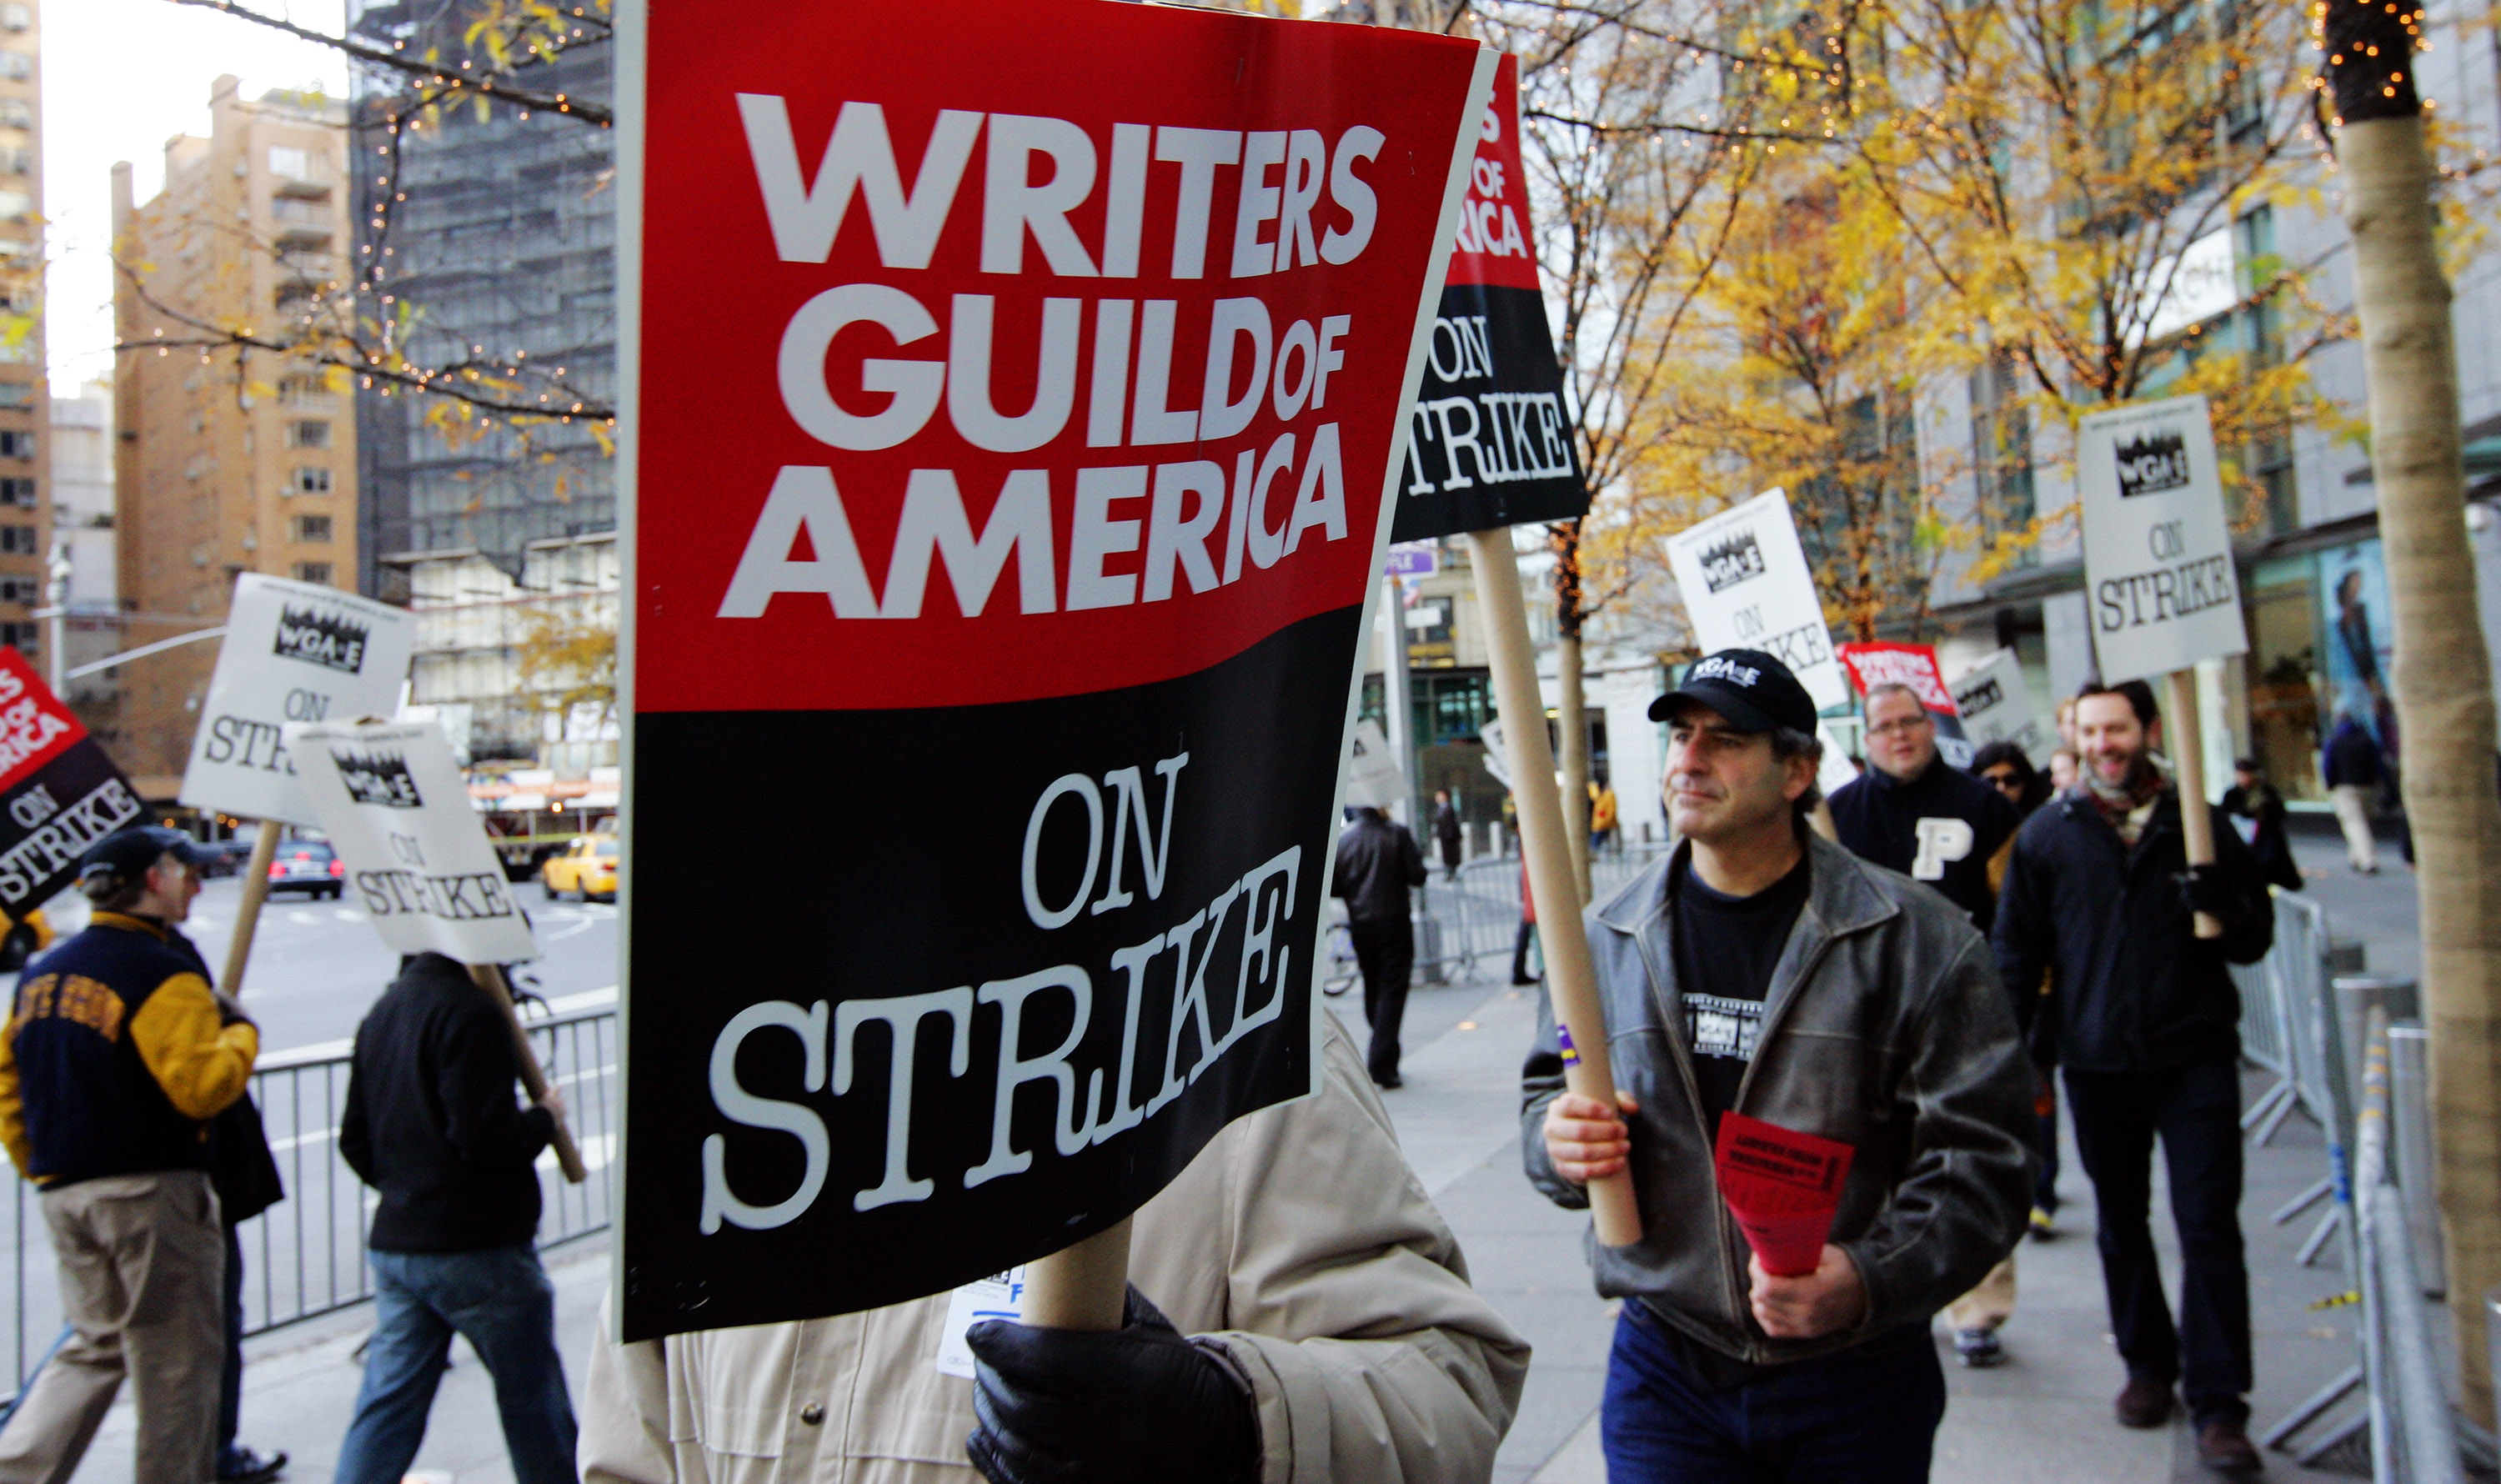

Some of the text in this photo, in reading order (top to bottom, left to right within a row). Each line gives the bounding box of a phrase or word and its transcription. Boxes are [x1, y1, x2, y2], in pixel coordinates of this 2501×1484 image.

[734, 93, 1386, 279] WRITERS
[1472, 157, 1505, 198] OF
[777, 283, 1351, 453] GUILD OF
[1429, 316, 1493, 383] ON
[1408, 393, 1573, 497] TRIKE
[715, 422, 1348, 619] AMERICA
[2148, 519, 2185, 562] ON
[1732, 604, 1765, 640] ON
[2098, 554, 2233, 632] STRIKE
[283, 688, 331, 721] ON
[0, 778, 142, 905] STRIKE
[9, 783, 59, 829] ON
[1021, 751, 1189, 930] ON
[1912, 818, 1973, 880] P
[699, 845, 1301, 1236] STRIKE
